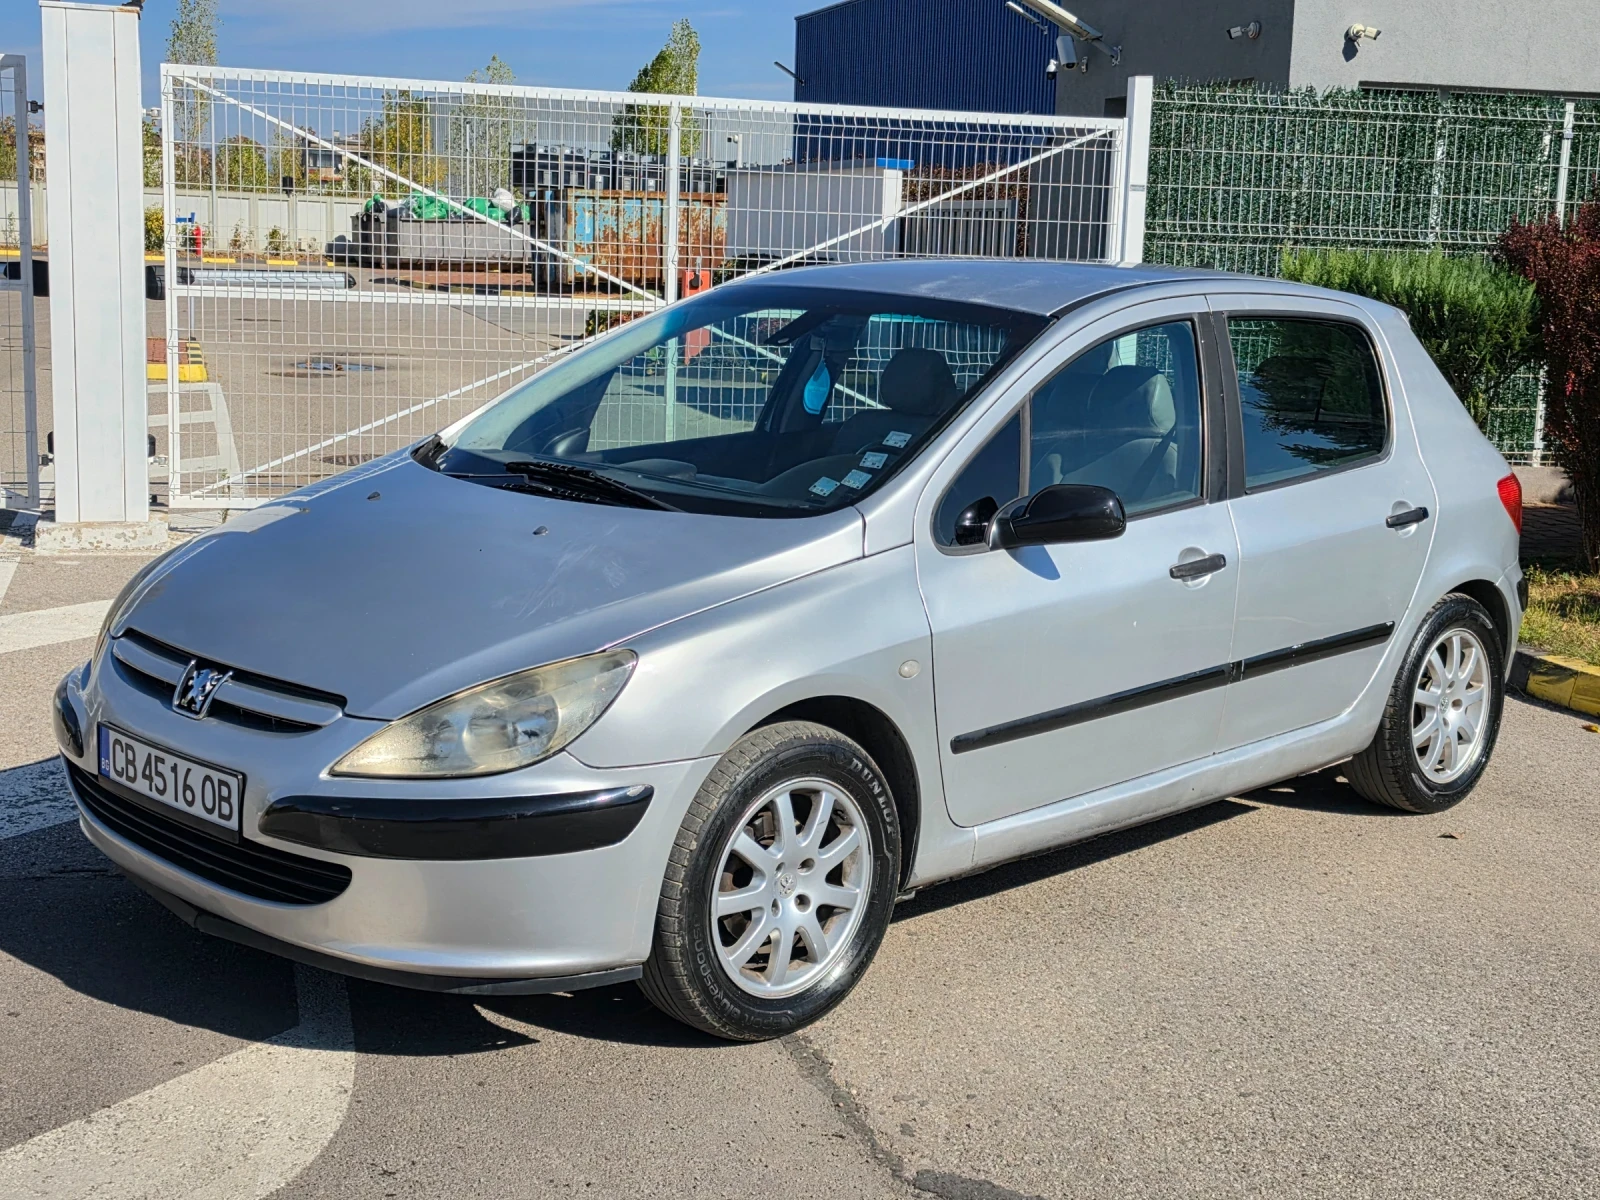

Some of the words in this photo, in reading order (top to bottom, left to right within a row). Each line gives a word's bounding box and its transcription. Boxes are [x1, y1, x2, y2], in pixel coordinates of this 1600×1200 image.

[101, 757, 110, 771] BG
[112, 738, 138, 784] CB
[142, 752, 196, 808] 4516
[201, 774, 233, 822] OB
[850, 758, 897, 839] DUNLOP
